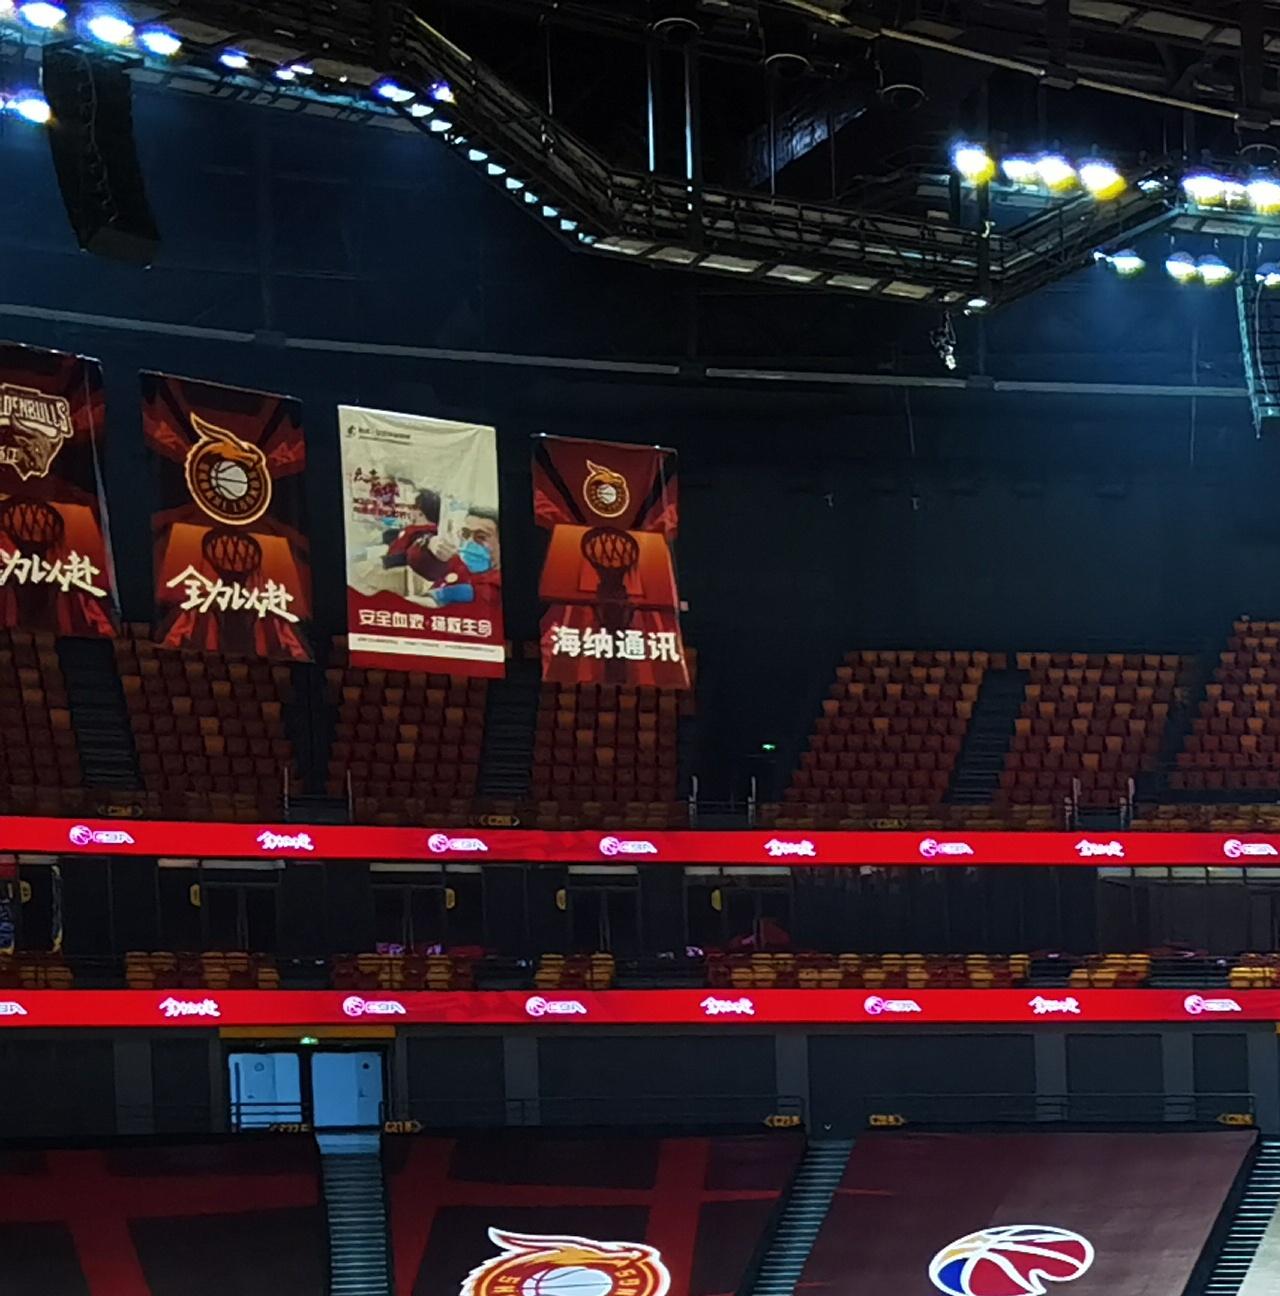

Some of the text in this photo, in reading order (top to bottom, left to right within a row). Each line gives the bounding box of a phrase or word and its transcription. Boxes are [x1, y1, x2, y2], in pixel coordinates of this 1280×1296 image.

[0, 549, 107, 597] 力以赴
[166, 565, 300, 623] 全力以赴
[551, 625, 681, 663] 海纳通讯
